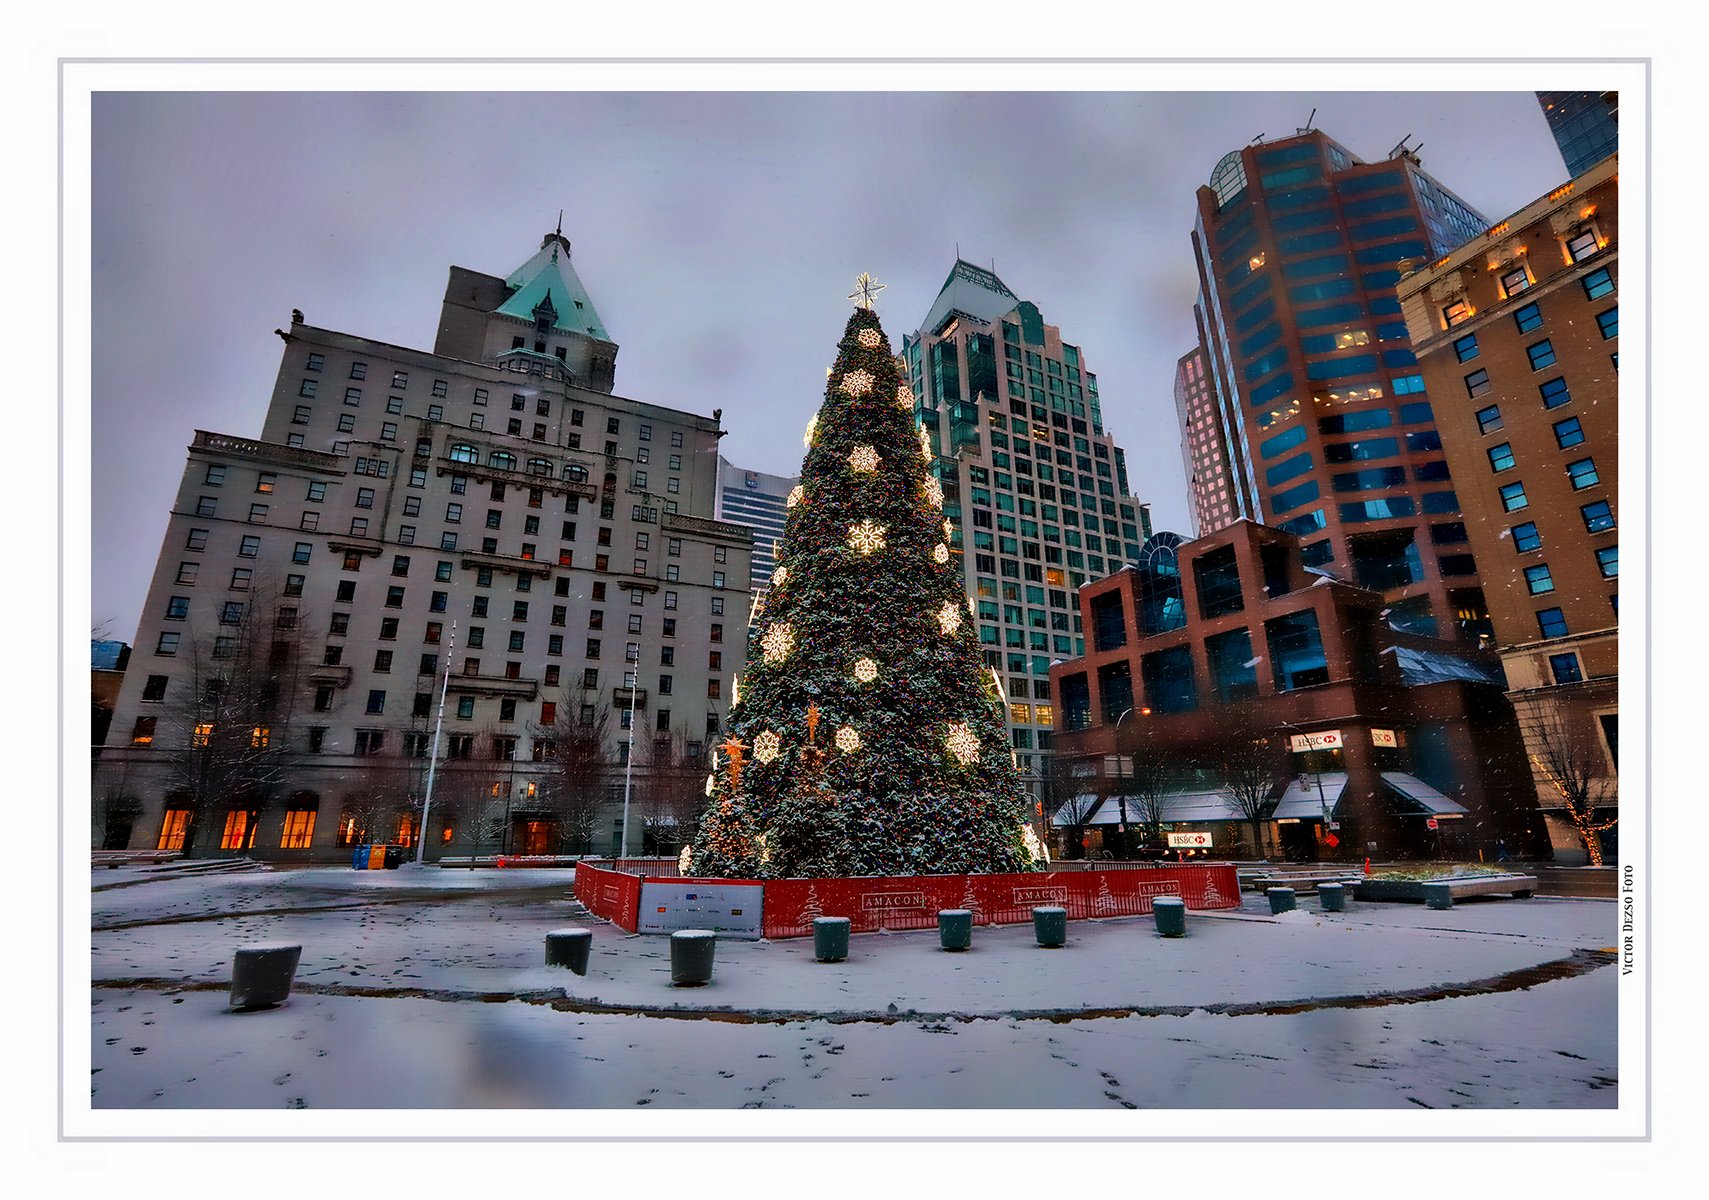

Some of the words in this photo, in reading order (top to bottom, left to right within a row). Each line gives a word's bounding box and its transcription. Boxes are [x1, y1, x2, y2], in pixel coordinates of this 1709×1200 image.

[1298, 736, 1323, 747] HSBC
[1372, 733, 1384, 742] SBC
[1173, 835, 1194, 845] HSBC
[1142, 884, 1178, 893] AMACON
[1017, 889, 1064, 900] AMACON
[865, 895, 920, 907] AMACON
